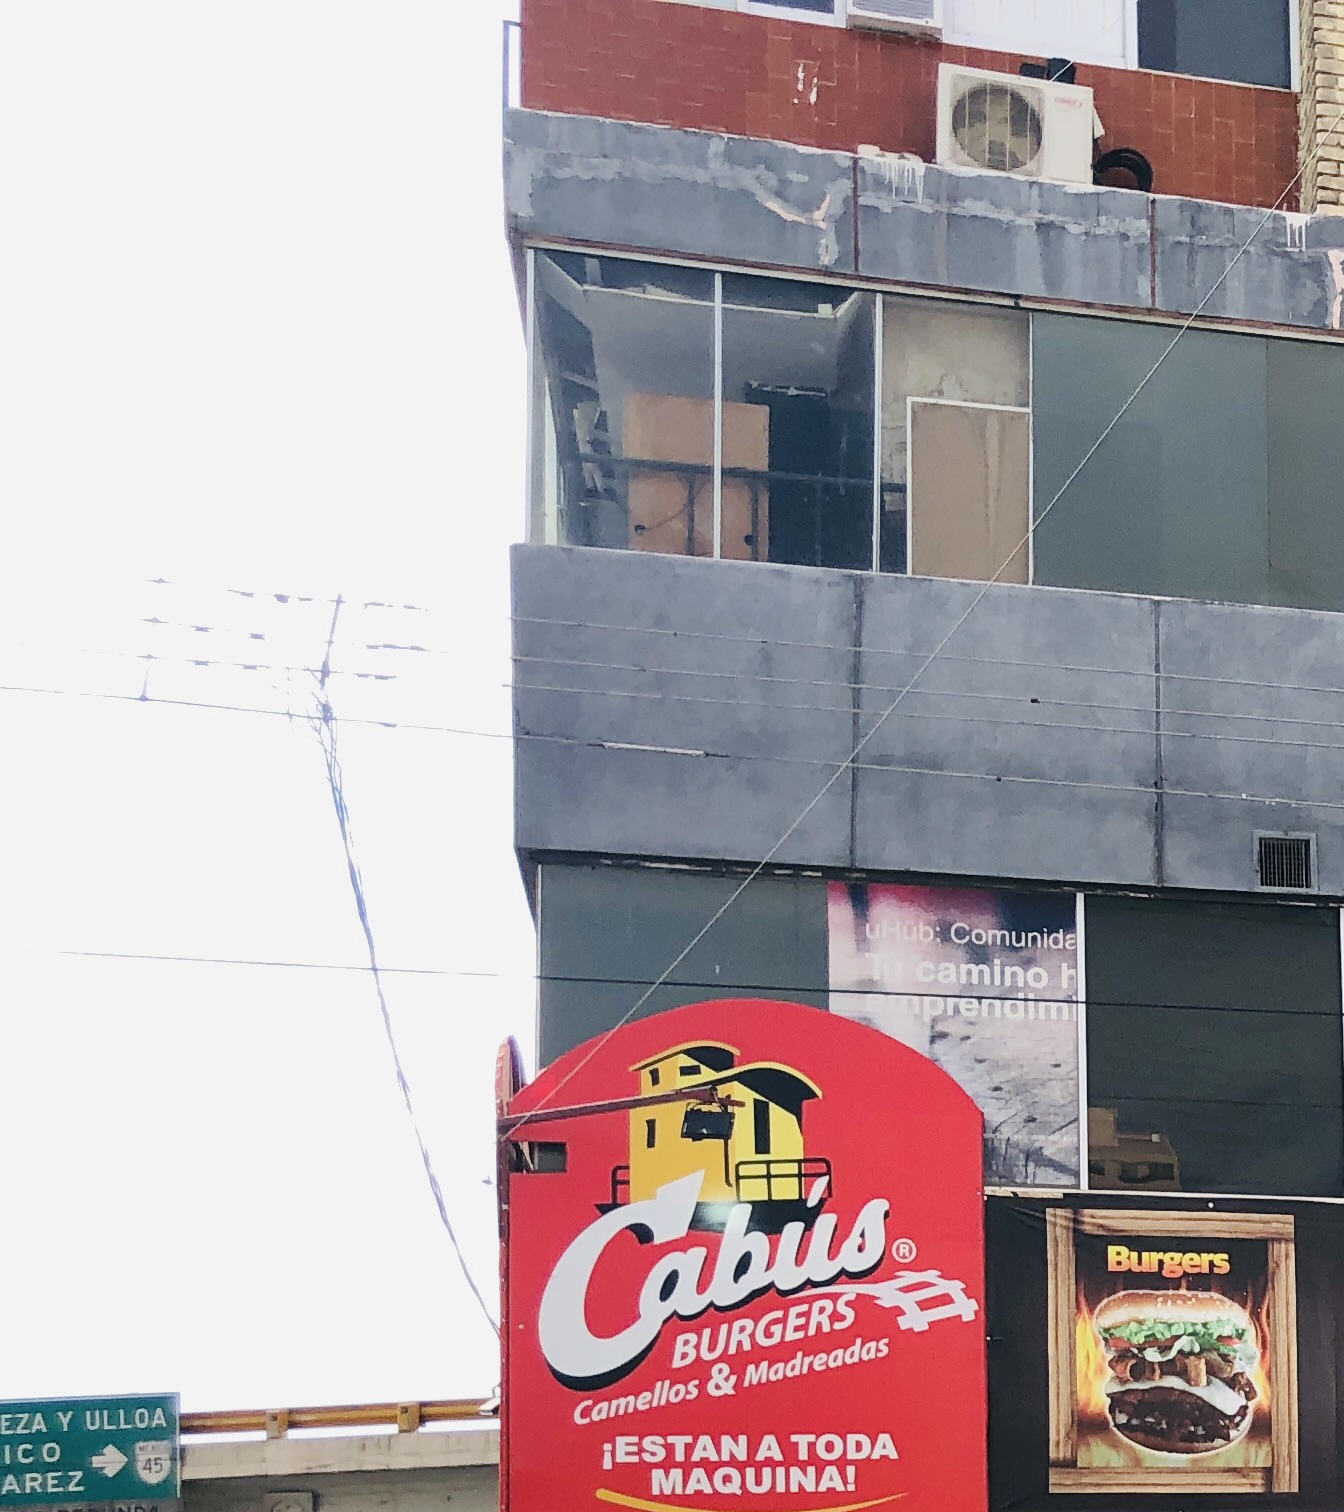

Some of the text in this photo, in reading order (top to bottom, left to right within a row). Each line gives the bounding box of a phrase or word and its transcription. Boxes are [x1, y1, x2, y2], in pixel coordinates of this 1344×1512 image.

[951, 922, 1077, 950] Comunida
[917, 959, 1048, 988] camino
[538, 1169, 890, 1380] Cabús
[1107, 1244, 1231, 1278] Burgers
[672, 1293, 857, 1368] BURGERS
[573, 1336, 889, 1425] Camellos & Madreadas
[57, 1411, 73, 1431] Y
[85, 1408, 167, 1430] ULLOA
[4, 1442, 61, 1465] ICO
[142, 1457, 163, 1473] 45
[603, 1434, 898, 1469] ¡ESTAN A TODA
[0, 1471, 85, 1494] AREZ
[652, 1466, 856, 1496] MAQUINA!
